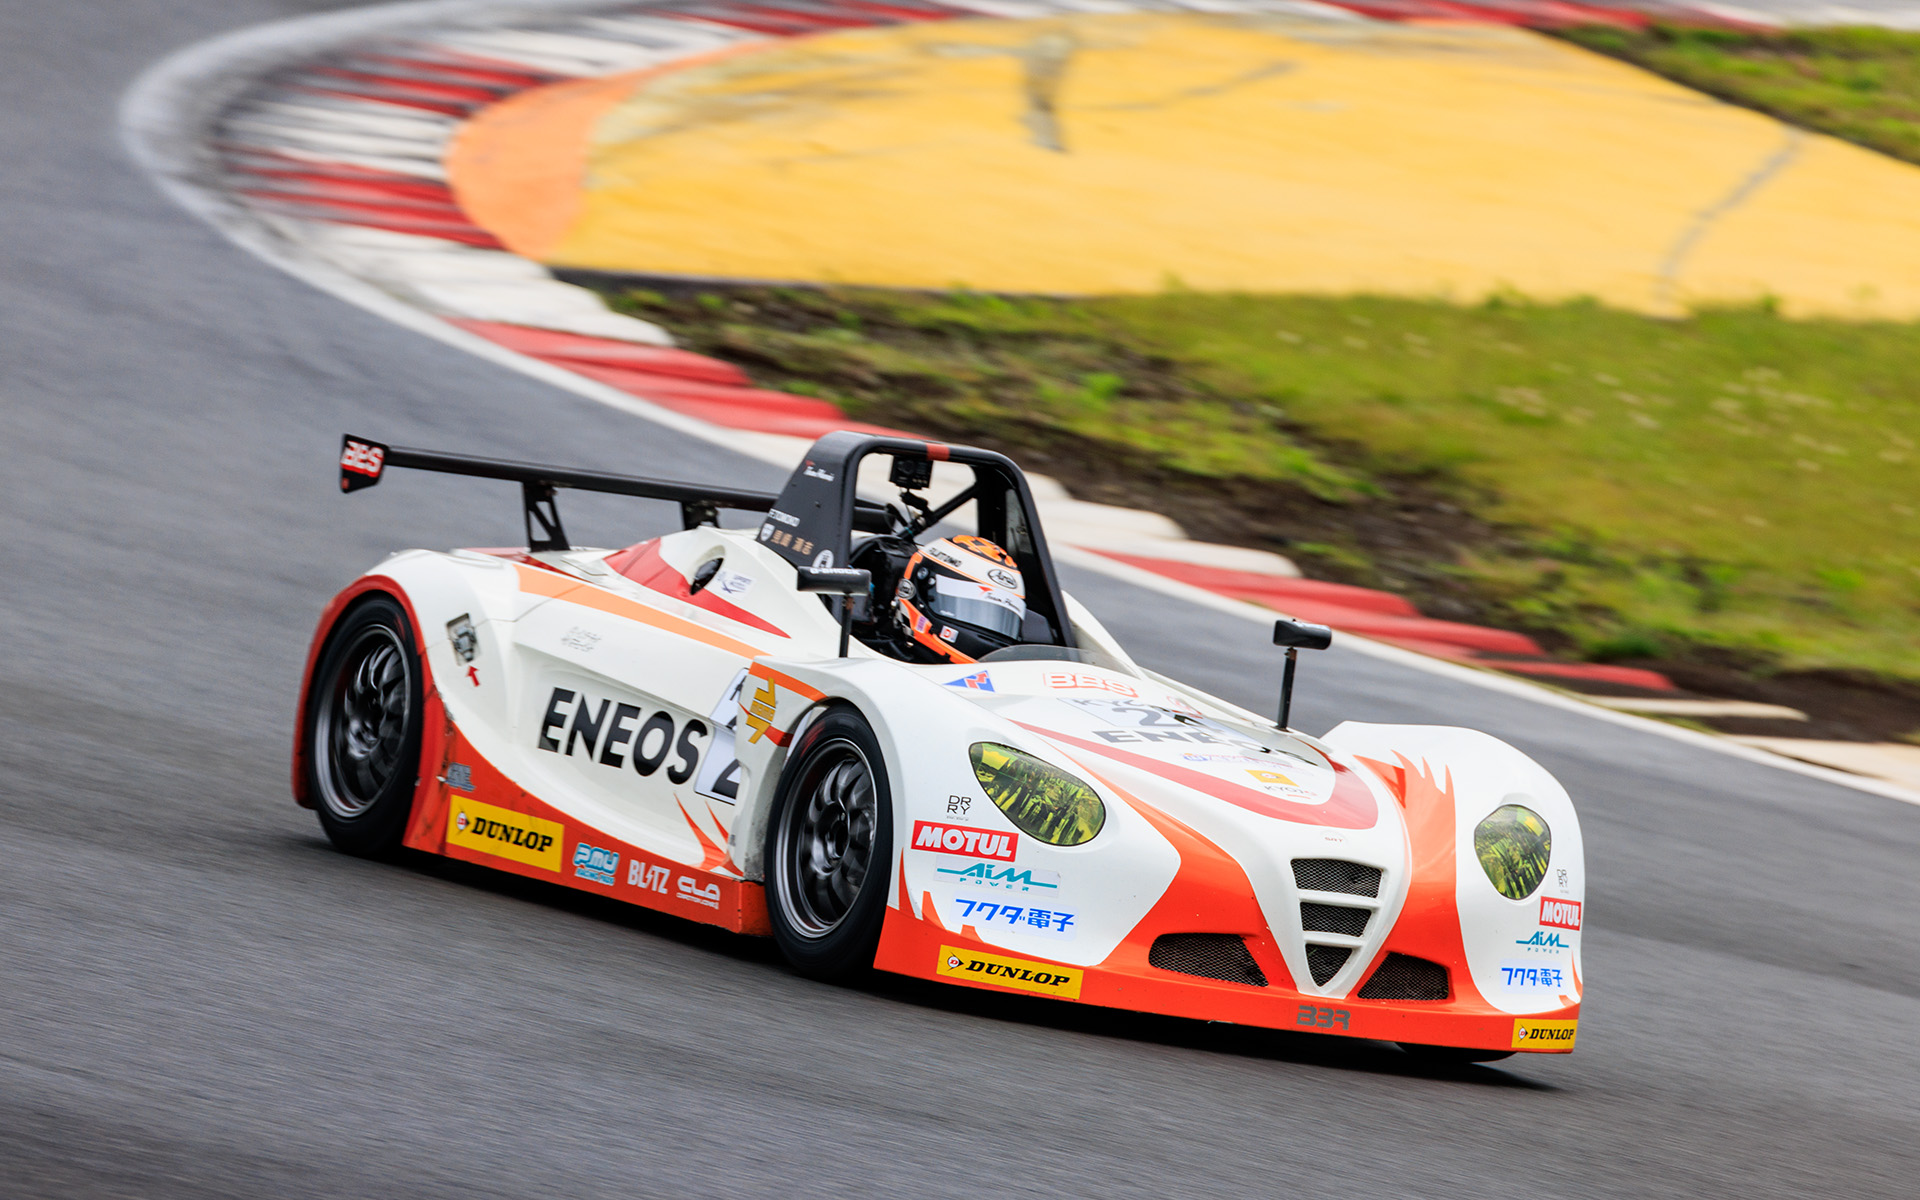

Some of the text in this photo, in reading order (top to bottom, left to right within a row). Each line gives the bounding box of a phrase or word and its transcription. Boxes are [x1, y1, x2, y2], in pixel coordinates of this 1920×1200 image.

[341, 440, 384, 474] BBS
[1043, 672, 1139, 698] BBS
[538, 687, 708, 785] ENEOS
[471, 817, 554, 853] DUNLOP
[915, 825, 1013, 858] MOTUL
[627, 859, 671, 895] BLITZ
[956, 899, 1075, 932] フクダ電子
[1541, 900, 1580, 927] MOTUL
[966, 960, 1070, 988] DUNLOP
[1501, 967, 1563, 987] フクダ電子
[1529, 1028, 1575, 1040] DUNLOP
